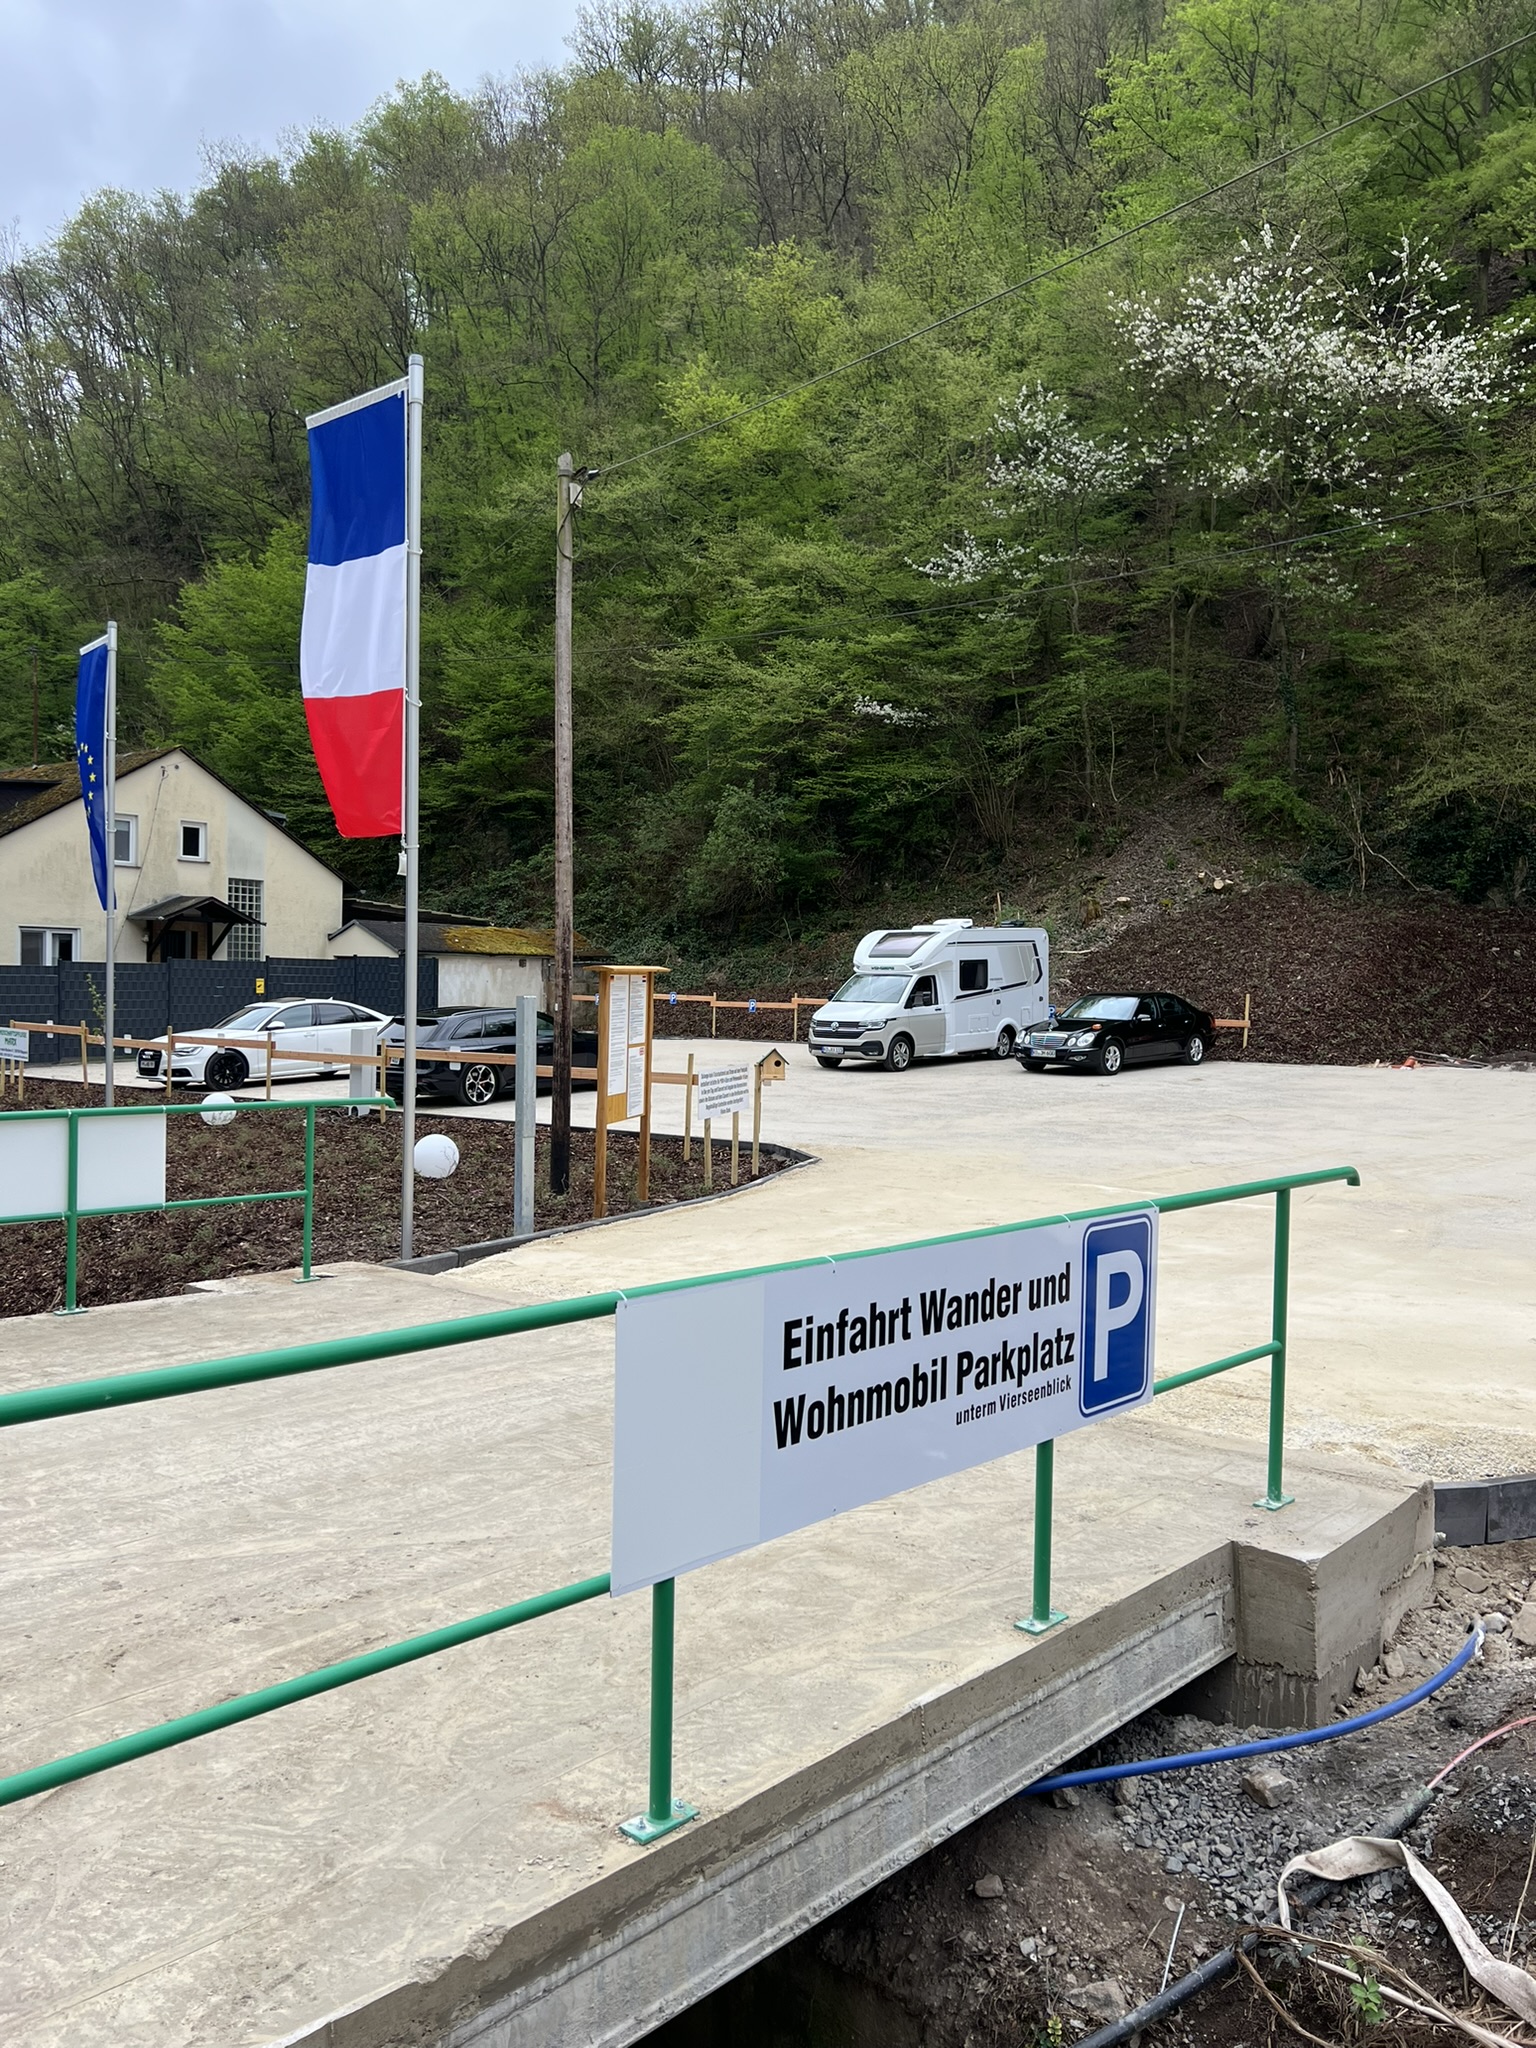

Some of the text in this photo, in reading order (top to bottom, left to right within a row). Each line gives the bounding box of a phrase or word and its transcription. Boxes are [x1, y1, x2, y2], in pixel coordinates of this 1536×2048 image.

[782, 1262, 1071, 1371] Einfahrt Wander und
[1094, 1250, 1144, 1382] P
[773, 1327, 1076, 1450] Wohnmobil Parkplatz
[955, 1374, 1072, 1426] unterm Vierseenblick
